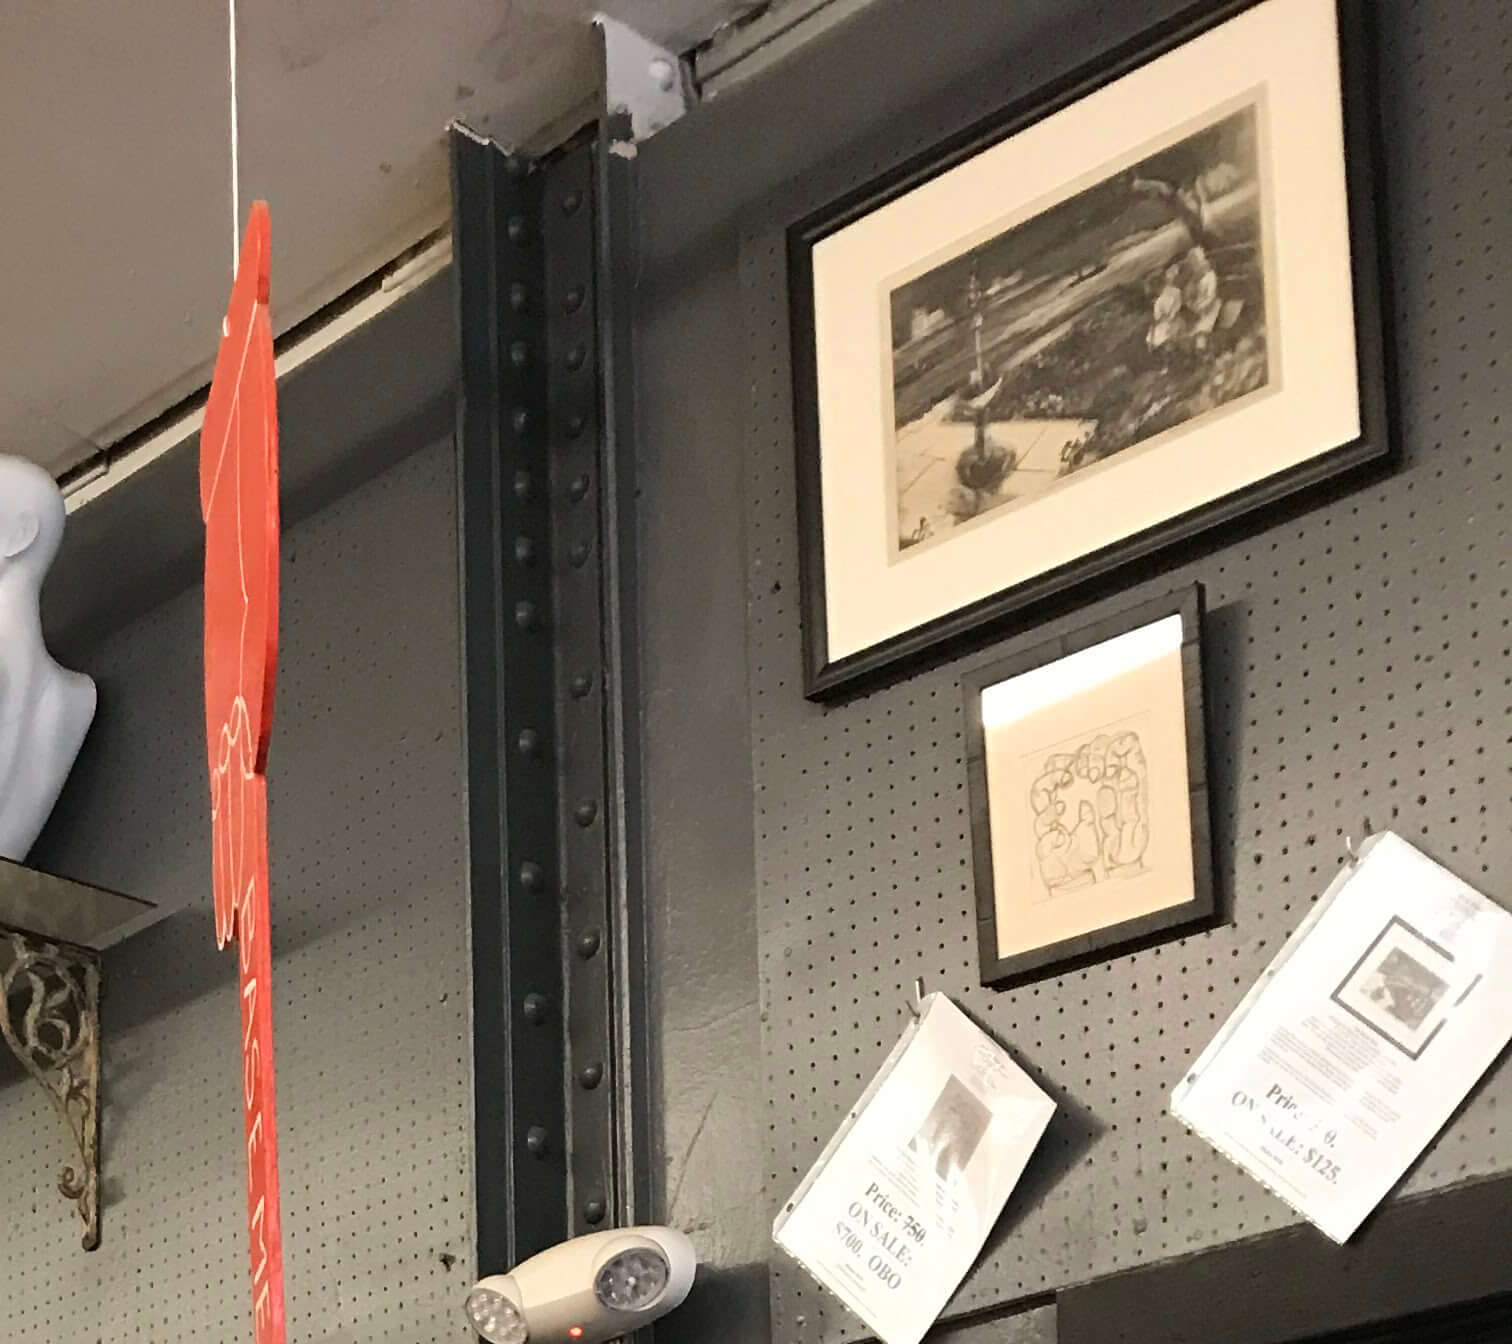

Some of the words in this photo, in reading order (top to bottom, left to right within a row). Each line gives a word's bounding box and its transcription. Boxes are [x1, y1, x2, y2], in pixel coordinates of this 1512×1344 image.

[1303, 1147, 1341, 1184] $125.
[865, 1182, 902, 1222] Price:
[836, 1221, 863, 1258] $700.
[868, 1255, 902, 1289] OBO
[848, 1201, 869, 1227] ON
[870, 1222, 912, 1266] SALE:
